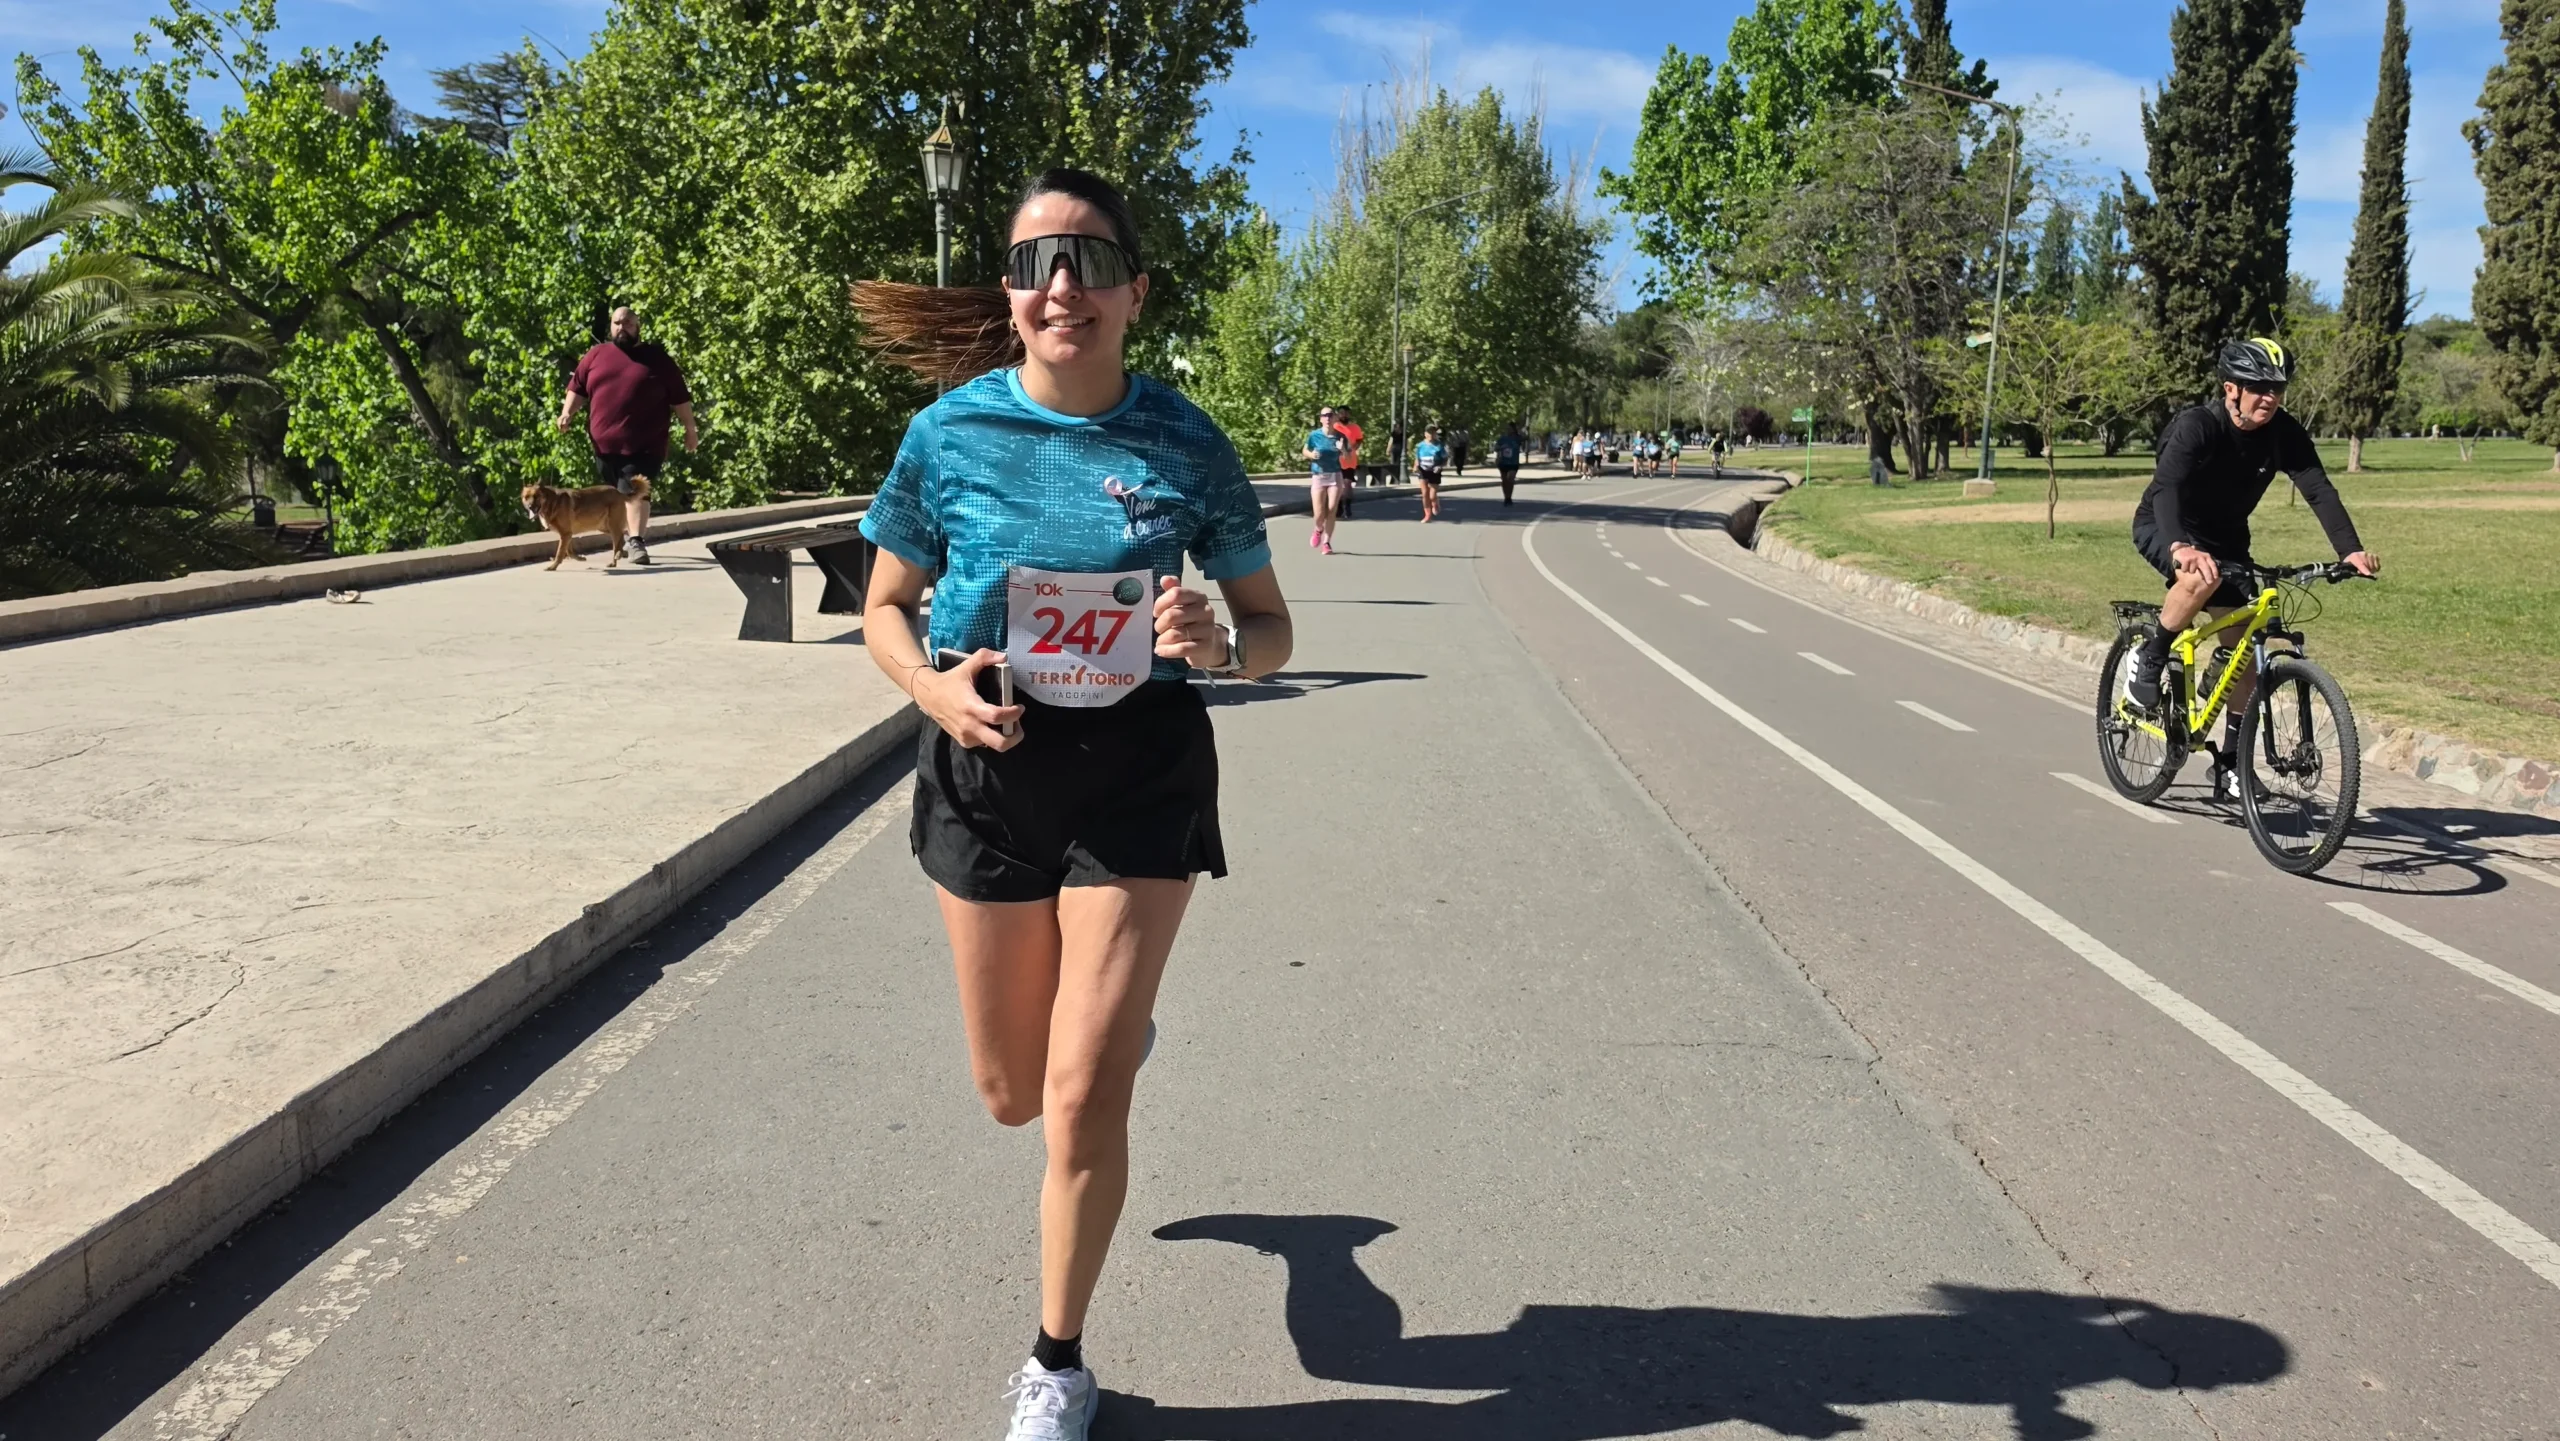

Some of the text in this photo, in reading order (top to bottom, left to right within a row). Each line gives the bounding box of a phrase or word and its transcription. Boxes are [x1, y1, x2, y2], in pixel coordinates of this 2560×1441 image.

[1033, 582, 1064, 597] 10k
[1027, 606, 1134, 656] 247
[1051, 690, 1105, 700] YACOPINI
